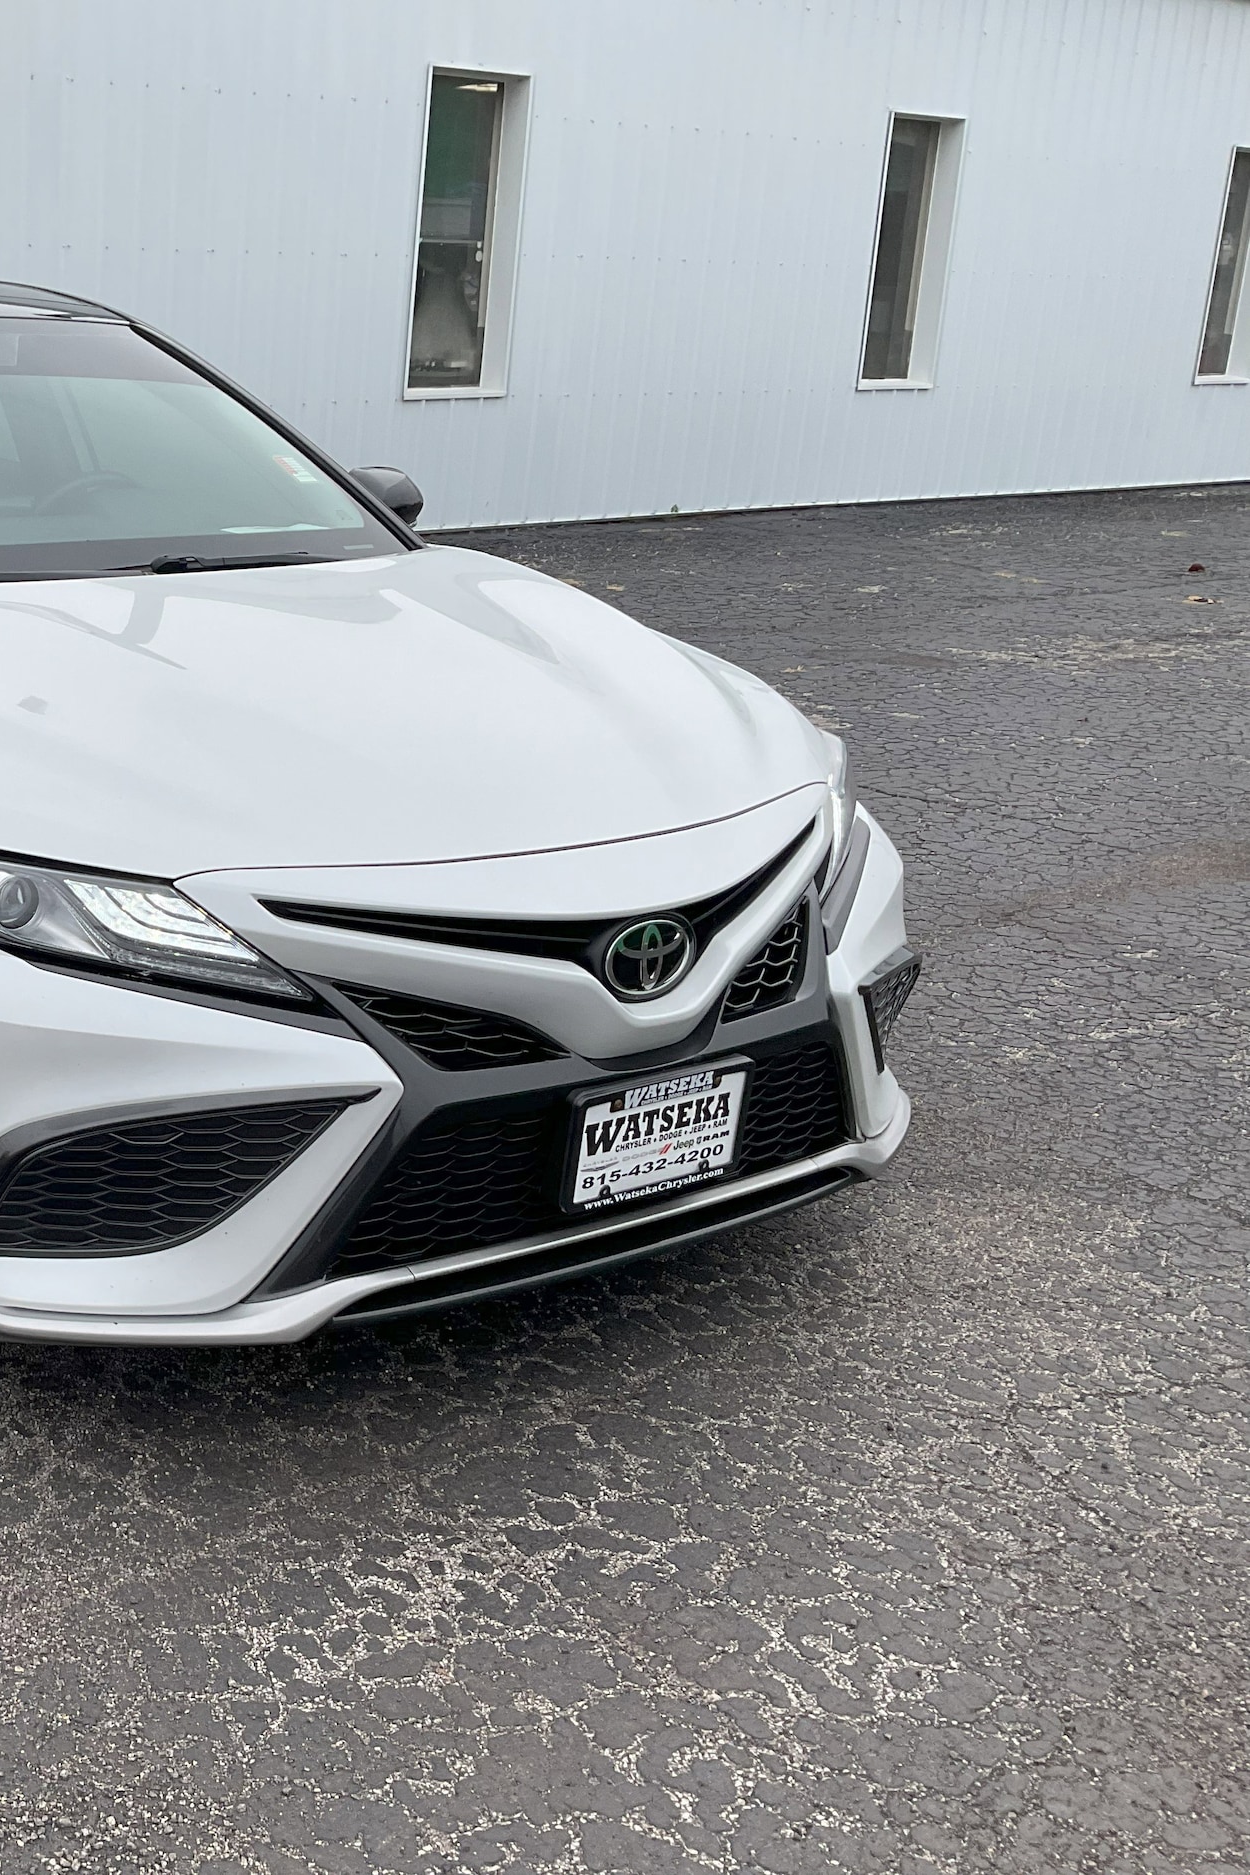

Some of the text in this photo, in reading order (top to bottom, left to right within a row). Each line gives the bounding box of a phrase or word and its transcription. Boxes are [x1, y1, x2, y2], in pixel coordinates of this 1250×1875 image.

[624, 1070, 715, 1110] WATSEKA
[584, 1092, 731, 1157] WATSEKA
[615, 1118, 728, 1153] CHRYSLER DODGE JEEP RAM
[673, 1139, 695, 1151] Jeep
[703, 1130, 730, 1142] RAM
[582, 1144, 724, 1190] 815-432-4200
[584, 1167, 724, 1211] www.WatsekaChrysler.com
